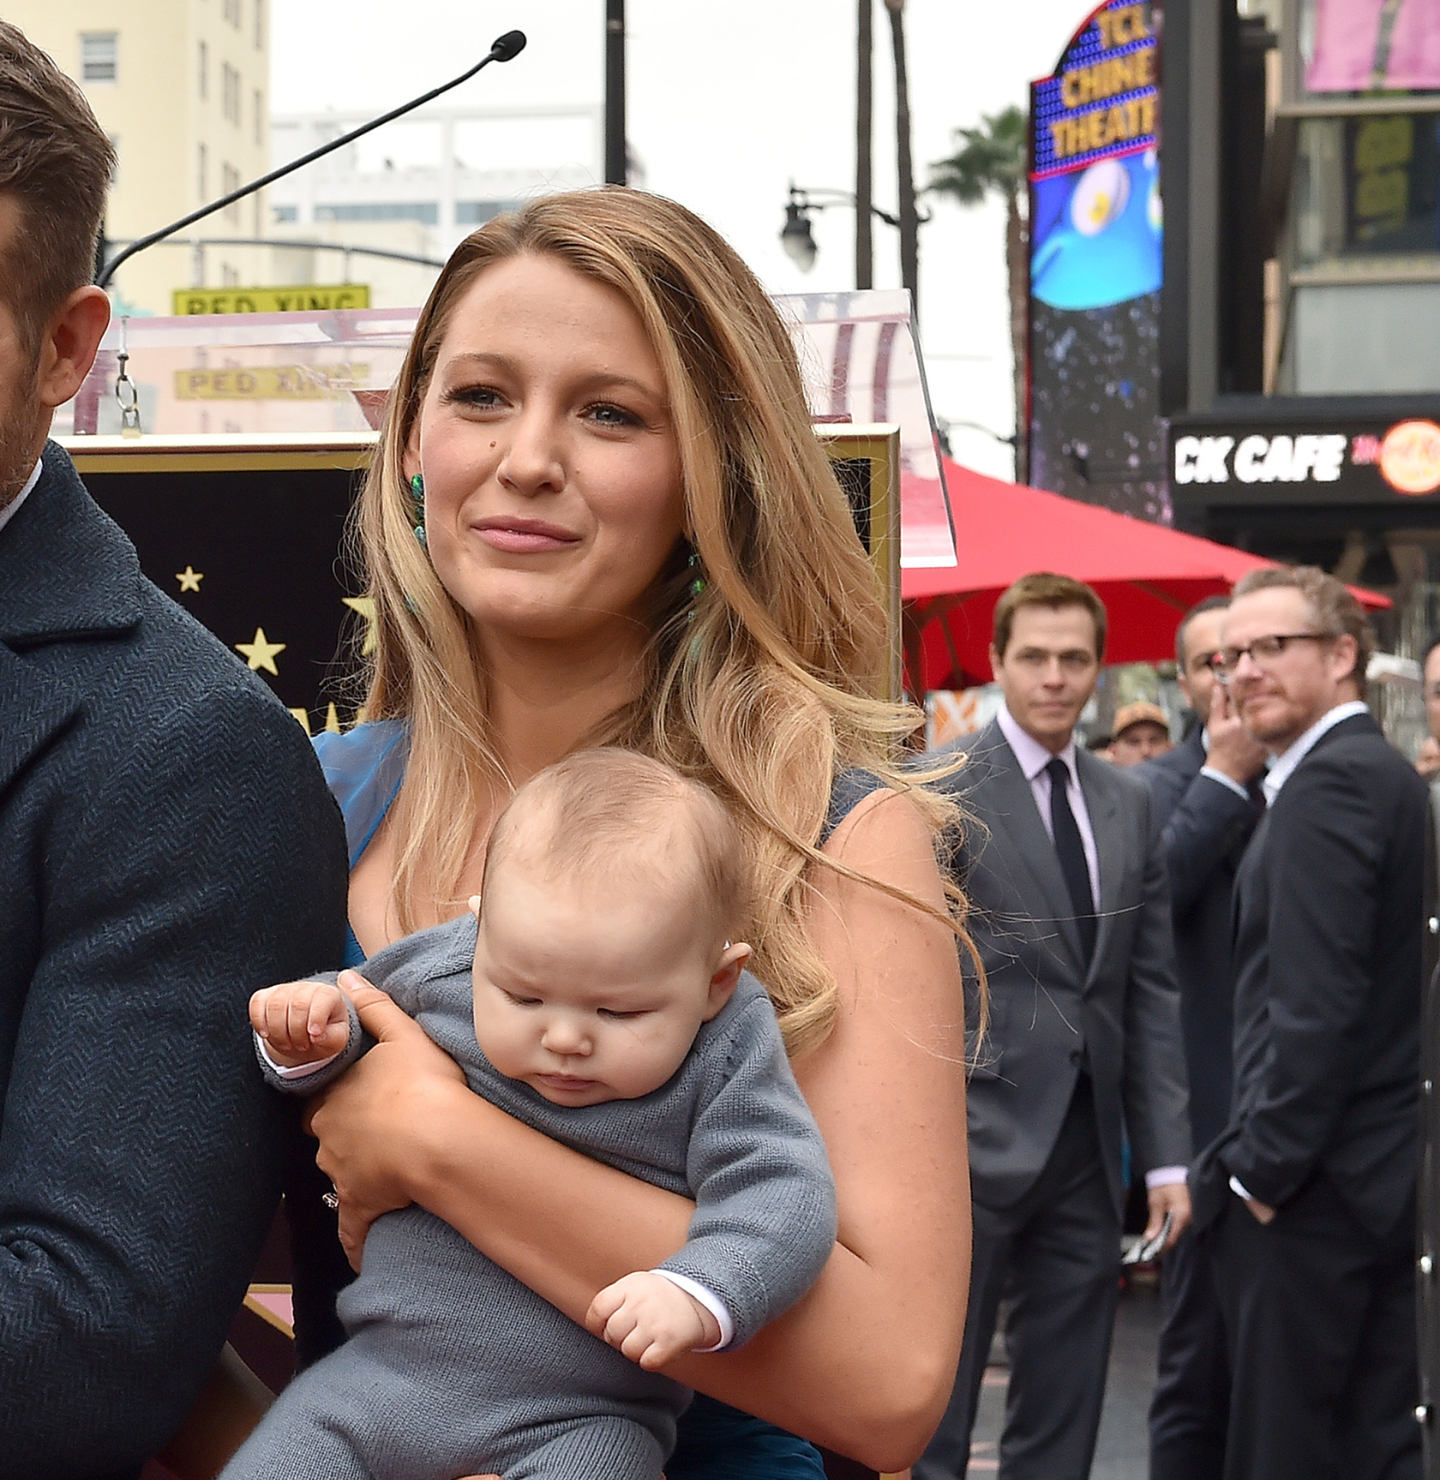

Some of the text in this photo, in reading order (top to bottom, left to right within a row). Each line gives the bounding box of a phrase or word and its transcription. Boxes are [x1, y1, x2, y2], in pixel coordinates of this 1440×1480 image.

[1094, 5, 1151, 50] TCL
[187, 293, 355, 315] PED XING
[189, 373, 256, 394] PED
[1233, 434, 1347, 484] CAFE
